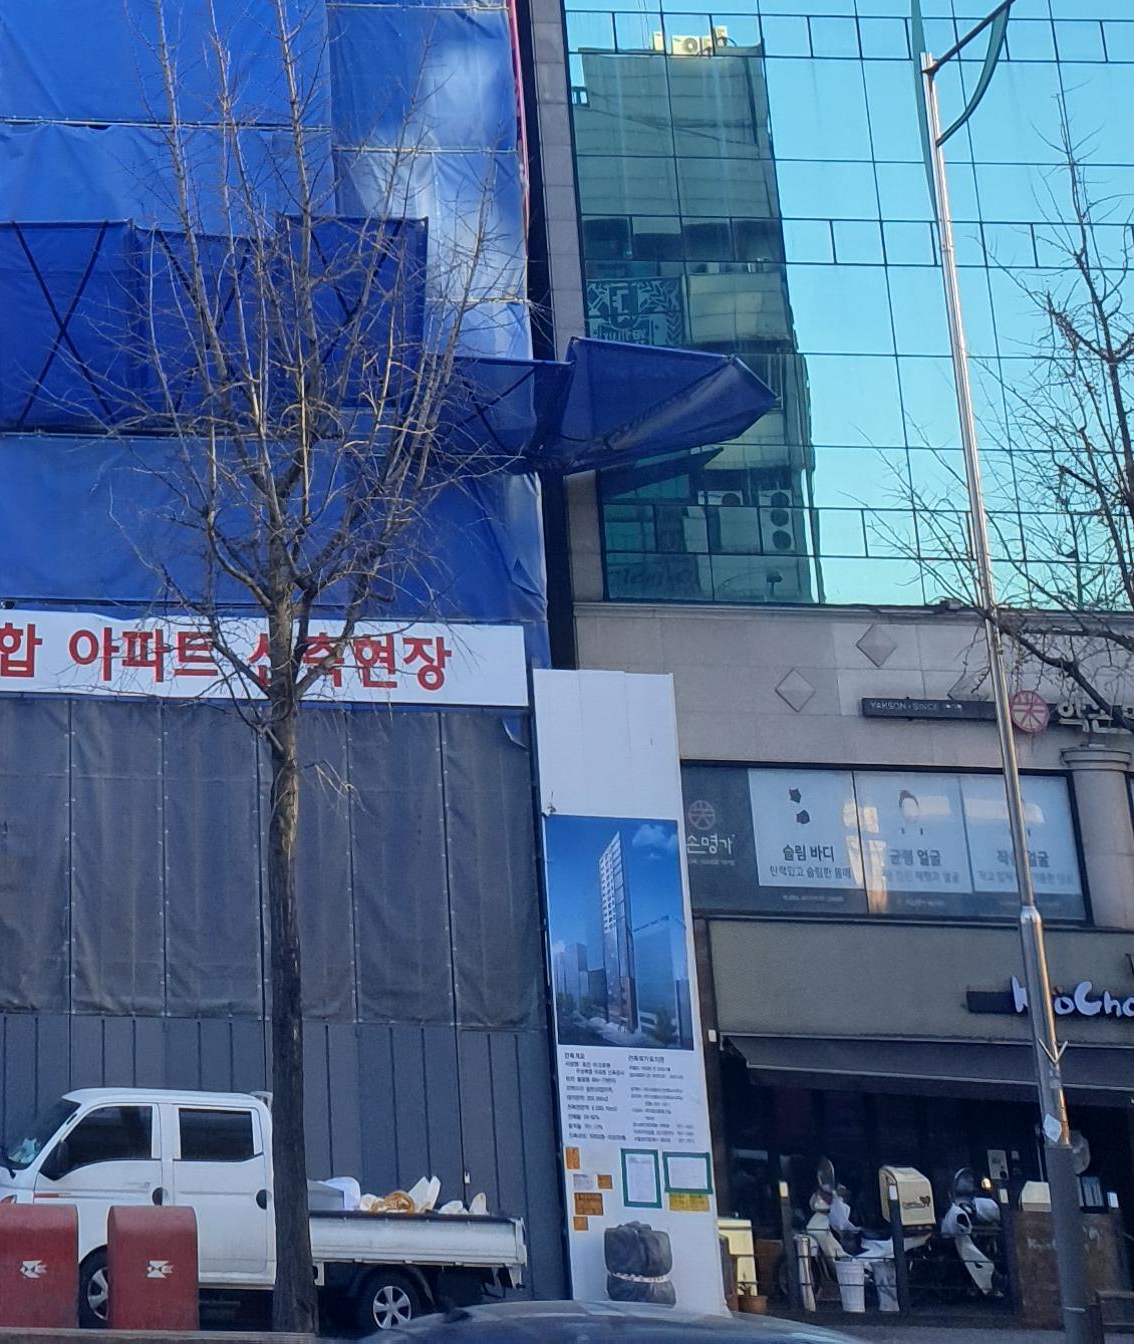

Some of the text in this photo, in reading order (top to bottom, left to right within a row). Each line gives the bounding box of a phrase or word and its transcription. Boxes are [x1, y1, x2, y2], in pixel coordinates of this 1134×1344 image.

[68, 626, 219, 684] 아파트
[782, 844, 835, 862] 슬림 바디
